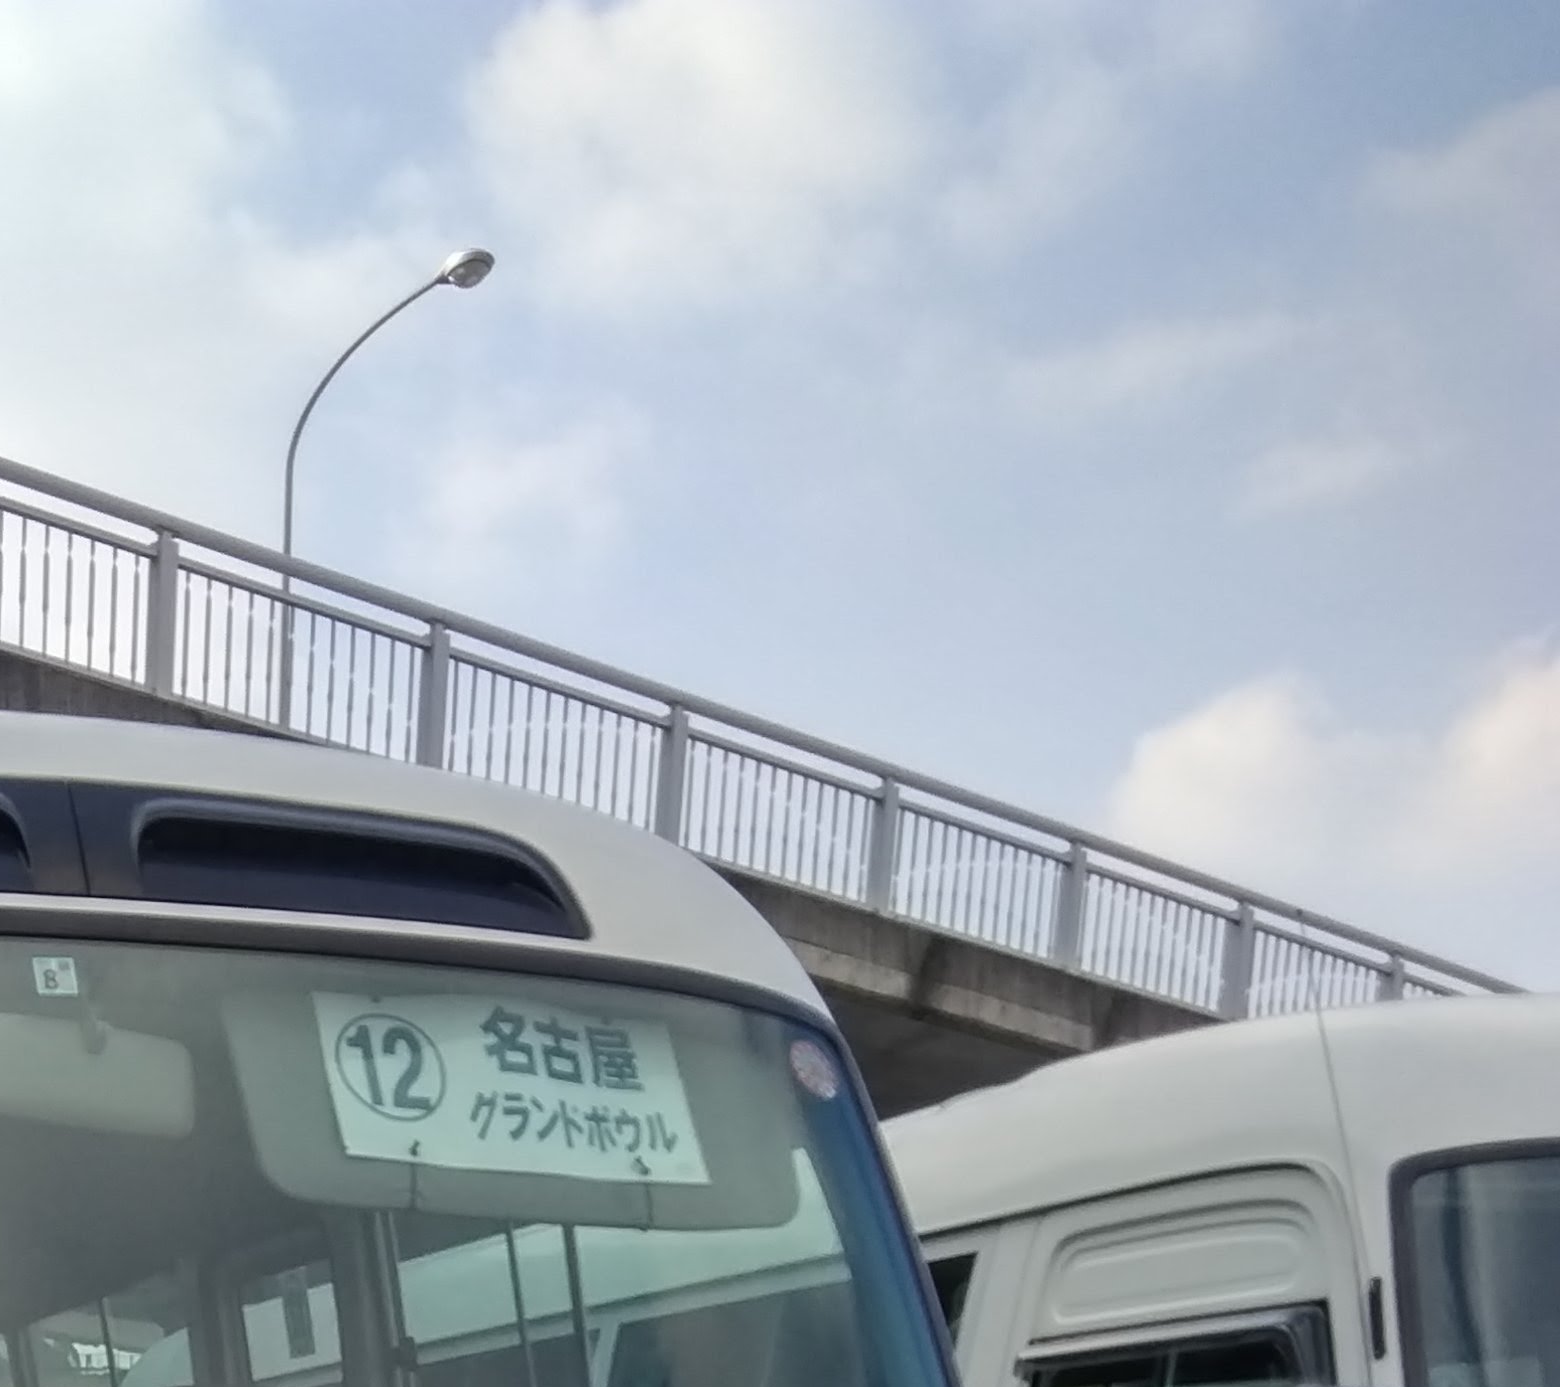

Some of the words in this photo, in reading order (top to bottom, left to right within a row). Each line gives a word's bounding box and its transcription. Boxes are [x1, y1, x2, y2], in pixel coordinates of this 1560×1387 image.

[344, 1022, 433, 1113] 12
[480, 1006, 645, 1091] 名古屋
[470, 1091, 679, 1153] グランドボウル
